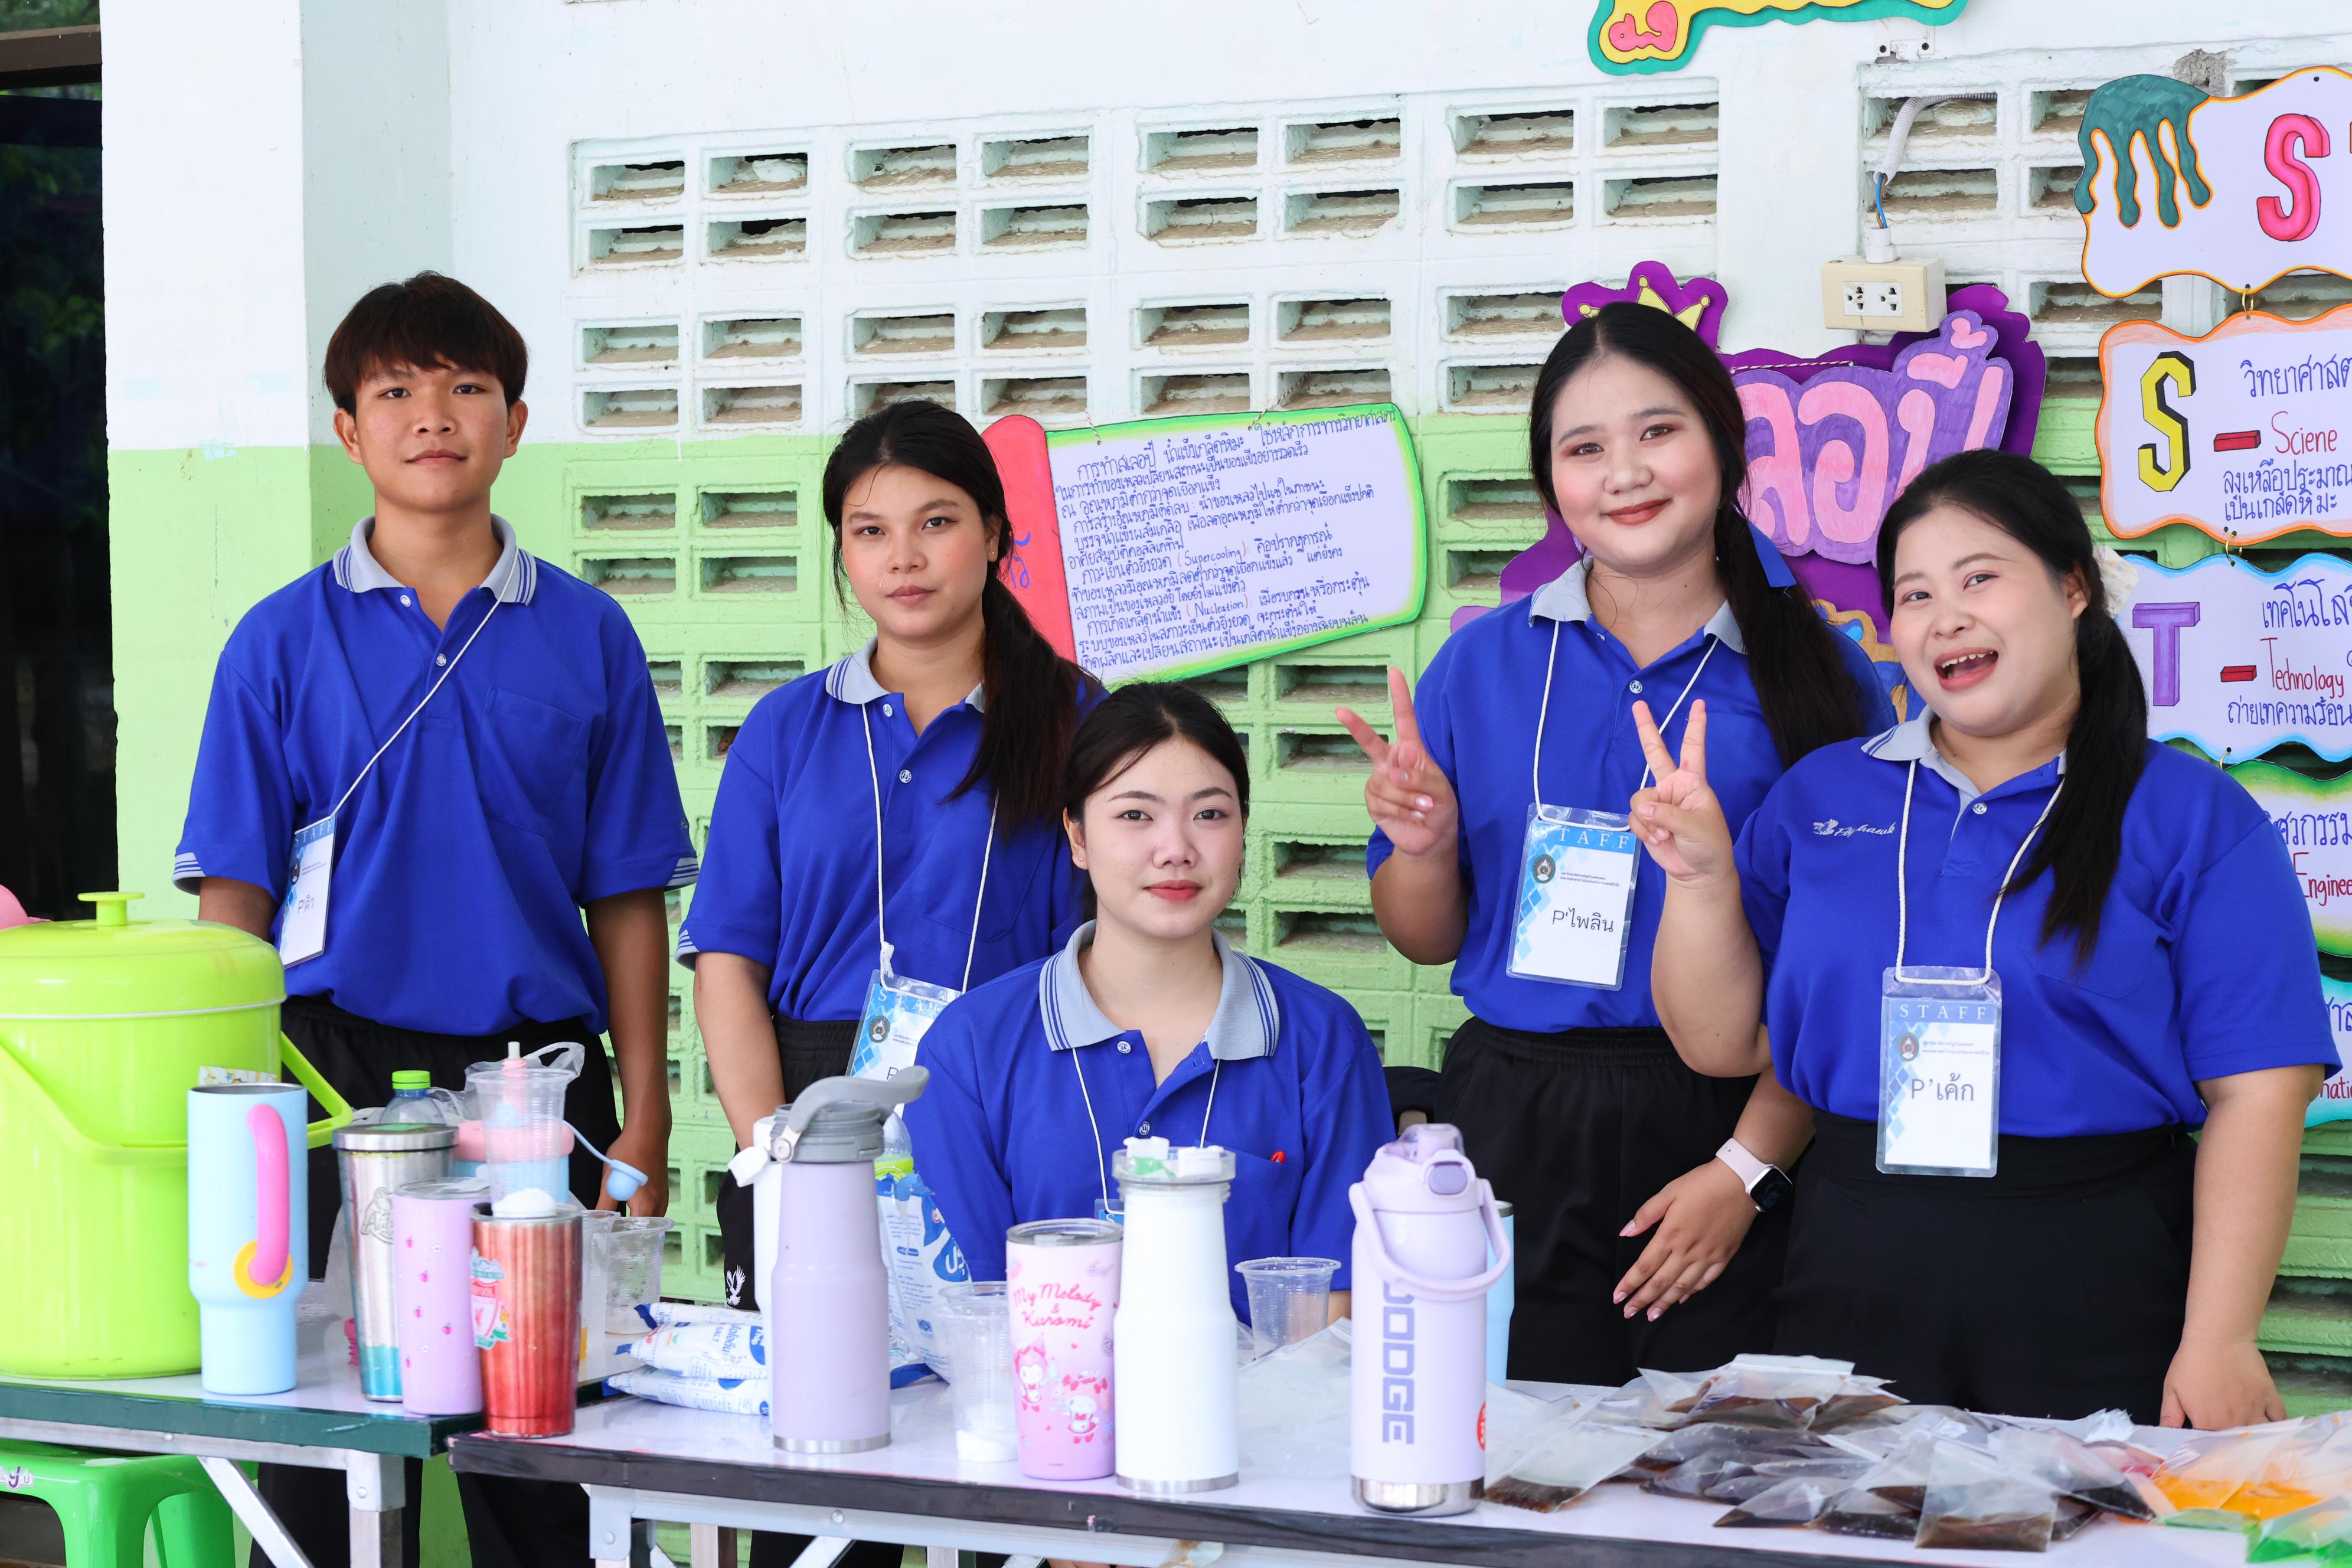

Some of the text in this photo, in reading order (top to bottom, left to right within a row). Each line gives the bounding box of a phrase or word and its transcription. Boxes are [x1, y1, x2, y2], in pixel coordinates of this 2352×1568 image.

[2256, 113, 2331, 242] S
[2138, 351, 2197, 492] S
[2271, 411, 2338, 456] Sciene
[2262, 579, 2352, 628] เทคโนโล
[2132, 602, 2200, 706] T
[2260, 638, 2344, 698] Technology
[1899, 1004, 1987, 1020] STAFF
[1012, 1282, 1102, 1312] My Melody
[1021, 1310, 1095, 1330] Kuromi
